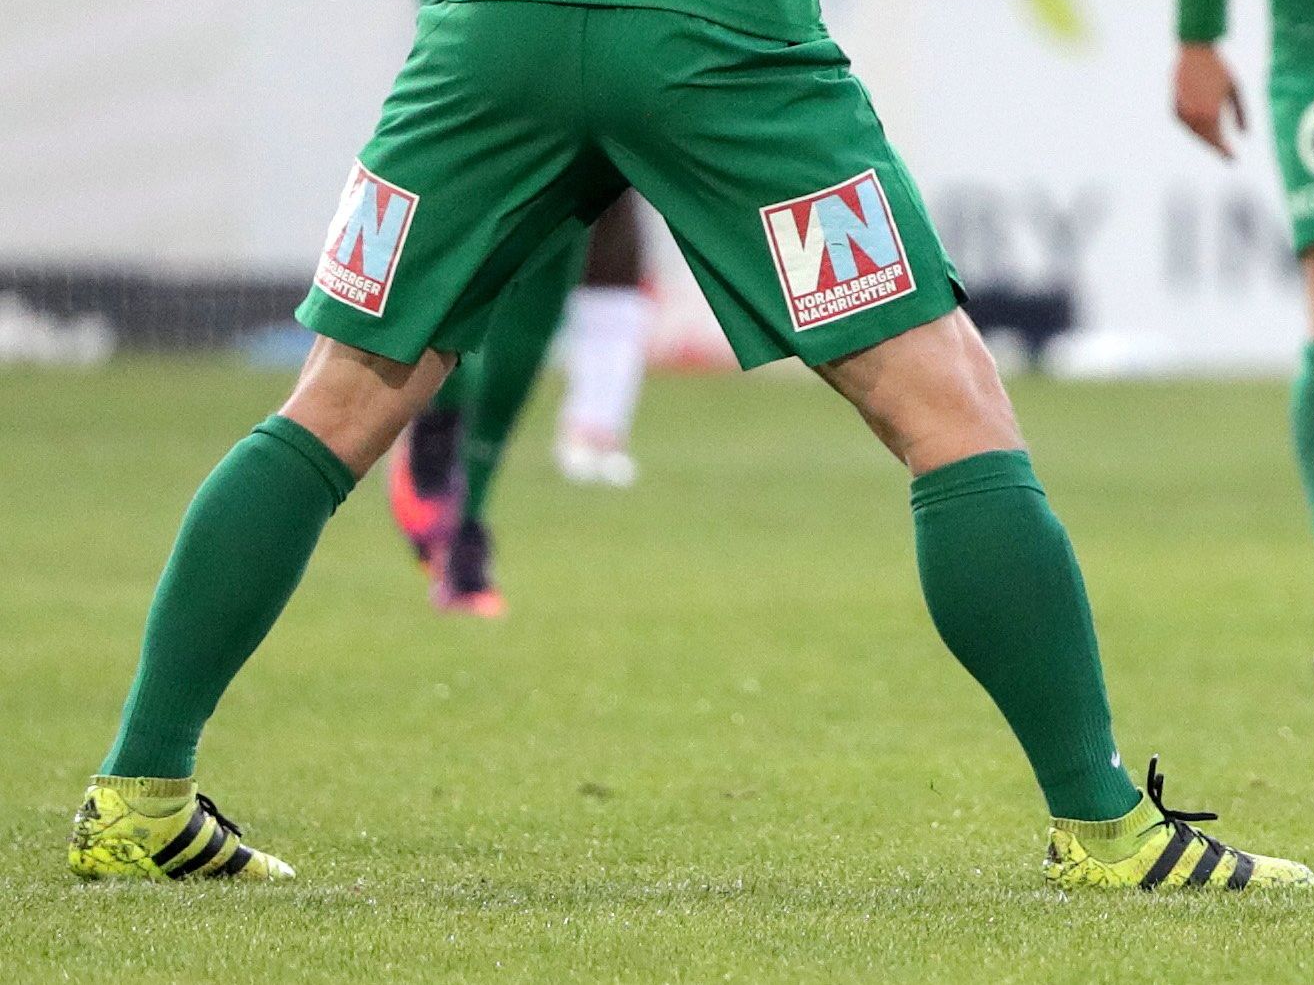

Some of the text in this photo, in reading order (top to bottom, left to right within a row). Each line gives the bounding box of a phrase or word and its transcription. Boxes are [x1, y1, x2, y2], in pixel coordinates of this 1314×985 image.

[769, 178, 899, 298] VN
[794, 264, 903, 310] VORARLBERGER
[797, 281, 897, 323] NACHRICHTEN
